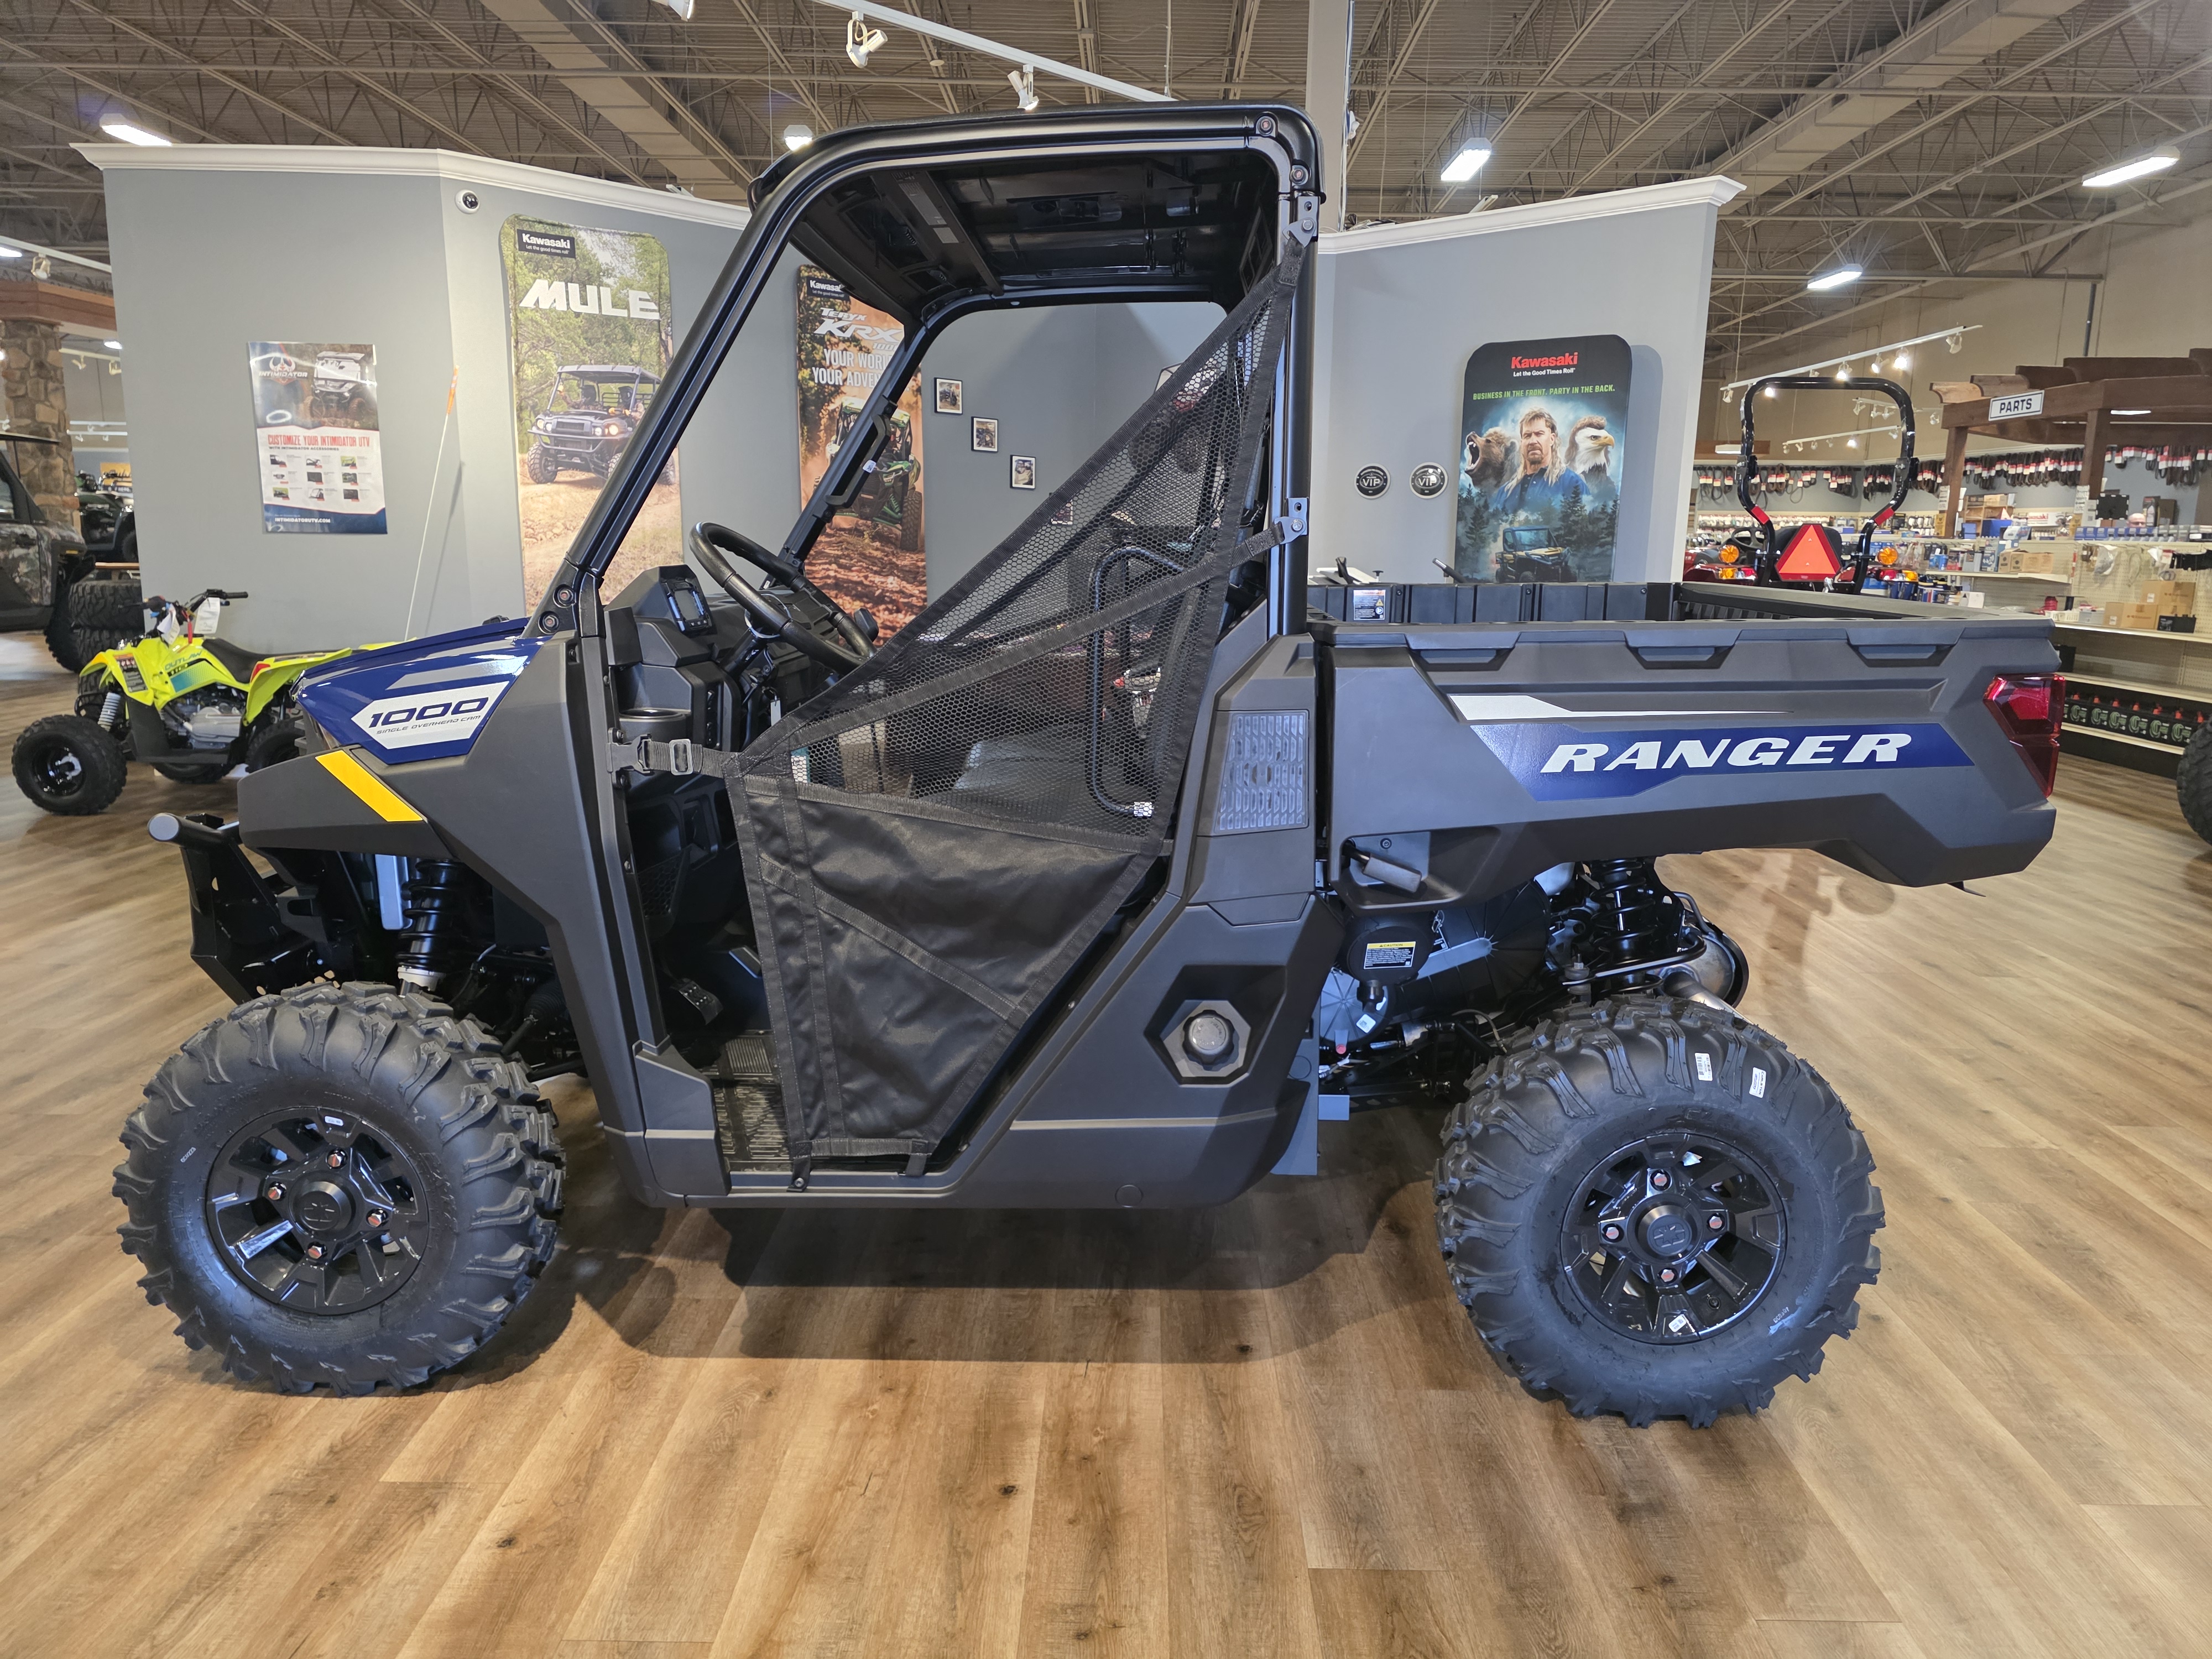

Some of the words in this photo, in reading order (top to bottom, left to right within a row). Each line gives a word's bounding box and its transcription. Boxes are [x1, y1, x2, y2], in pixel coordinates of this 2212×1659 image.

[522, 233, 570, 248] Kawasaki
[810, 280, 843, 293] Kawasa
[519, 279, 661, 320] MULE
[813, 318, 903, 343] KRX
[823, 348, 854, 367] YOUR
[1511, 352, 1578, 369] Kawasaki
[812, 367, 842, 385] YOUR
[1473, 392, 1503, 400] BUSINESS
[1525, 388, 1548, 397] FRONT.
[1549, 387, 1571, 395] PARTY
[1595, 384, 1615, 393] BACK.
[2000, 398, 2032, 414] PARTS
[268, 435, 301, 446] CUSTOMIZE
[303, 435, 319, 446] YOUR
[320, 436, 357, 447] INTIMIDATOR
[358, 436, 370, 447] UTV
[1418, 478, 1437, 486] VIP
[164, 650, 202, 671] OUTLAW
[368, 697, 489, 728] 1000
[376, 726, 409, 734] SINGLE
[411, 718, 459, 729] OVERHEAD
[1540, 733, 1912, 773] RANGER
